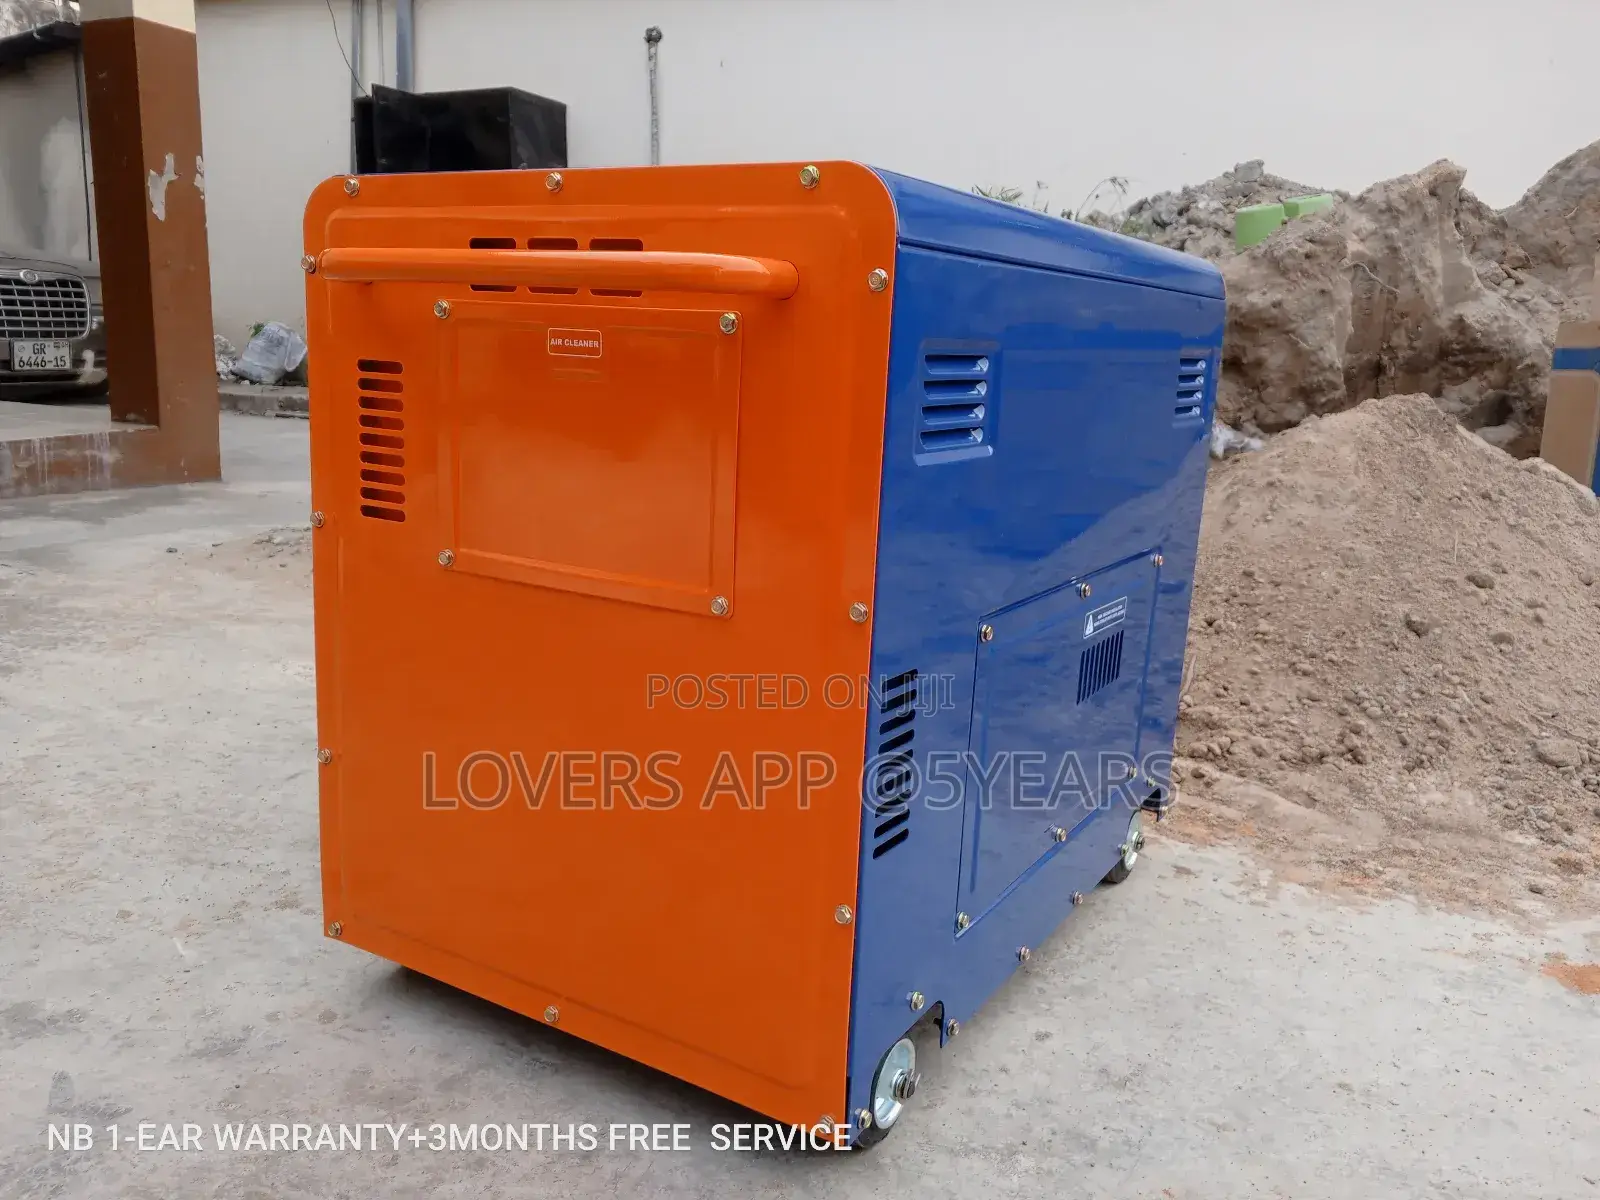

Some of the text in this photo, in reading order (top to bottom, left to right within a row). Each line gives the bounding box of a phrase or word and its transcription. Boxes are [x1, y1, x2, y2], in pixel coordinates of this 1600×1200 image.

[32, 343, 47, 355] GR
[550, 338, 599, 348] AIR CLEANER
[18, 355, 67, 368] 6446-15
